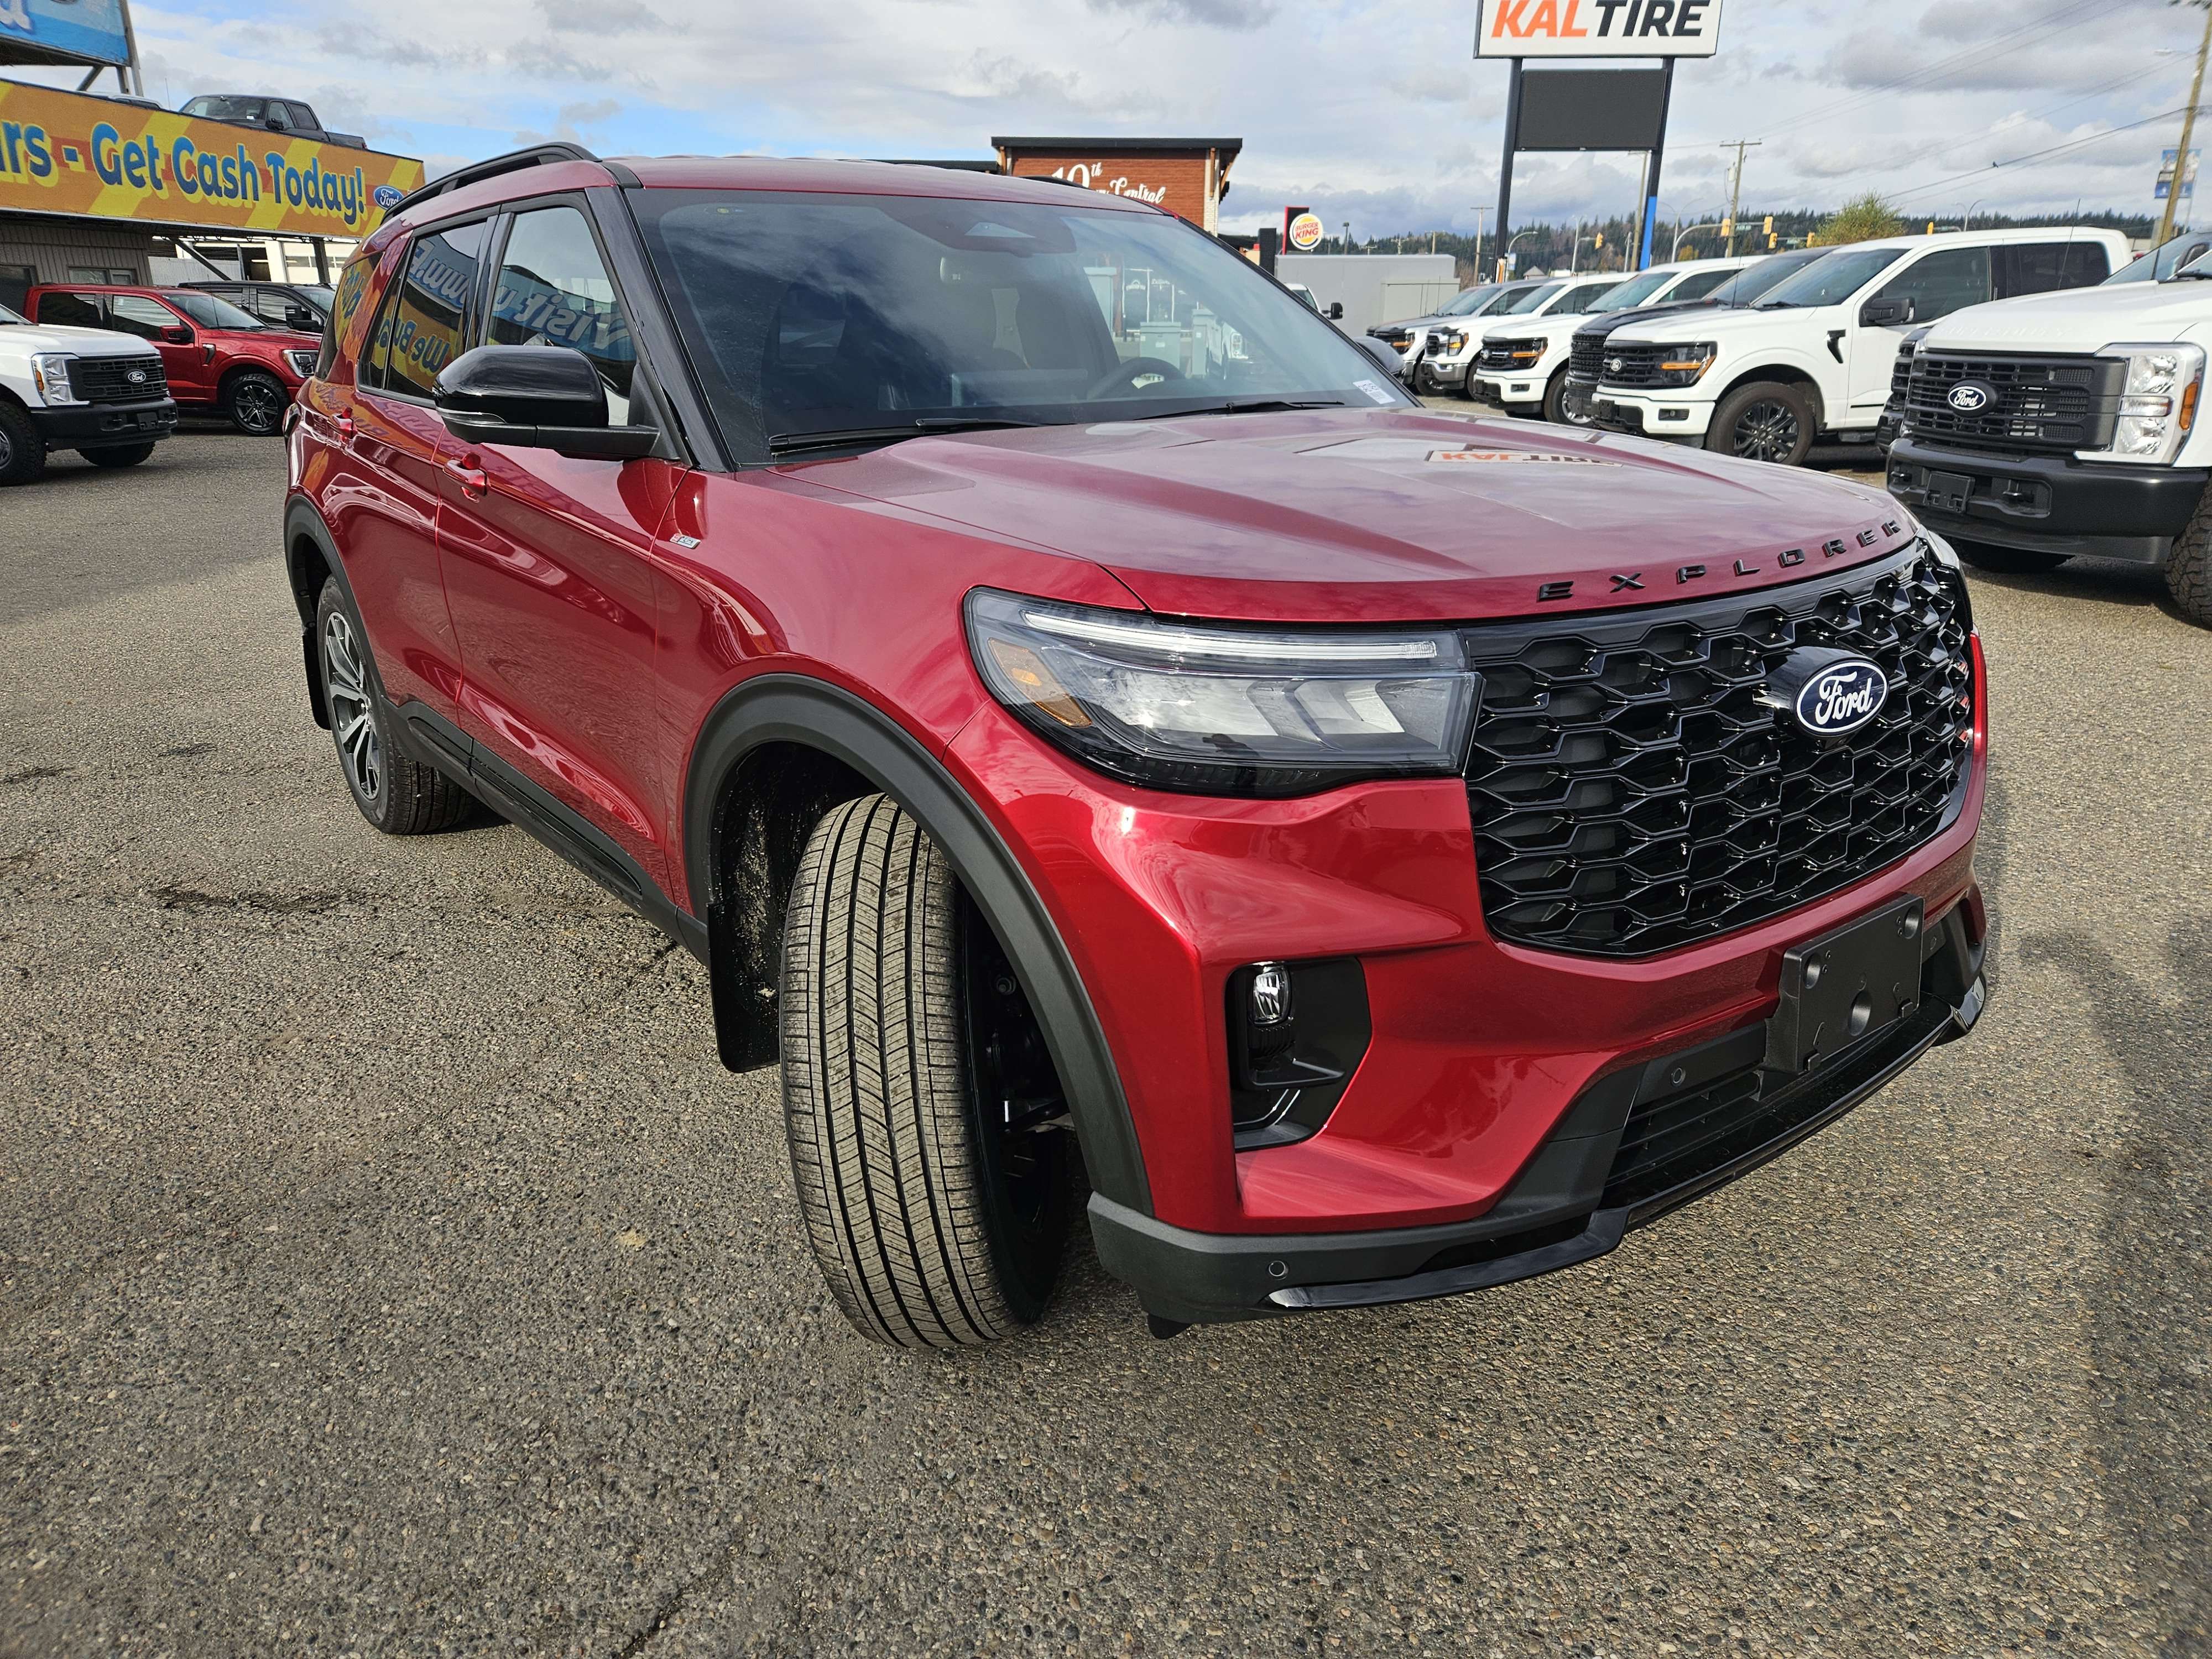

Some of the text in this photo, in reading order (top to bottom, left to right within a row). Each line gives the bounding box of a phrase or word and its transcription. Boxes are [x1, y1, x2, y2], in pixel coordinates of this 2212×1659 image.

[1491, 0, 1710, 38] KAL TIRE
[0, 121, 51, 177] rs
[91, 123, 164, 191] Get
[172, 136, 259, 201] Cash
[265, 152, 364, 225] Today!
[380, 188, 399, 207] Ford
[1295, 228, 1319, 239] KING
[1954, 389, 1979, 406] Ford
[1538, 519, 1902, 602] EXPLORER
[1815, 671, 1873, 725] Ford
